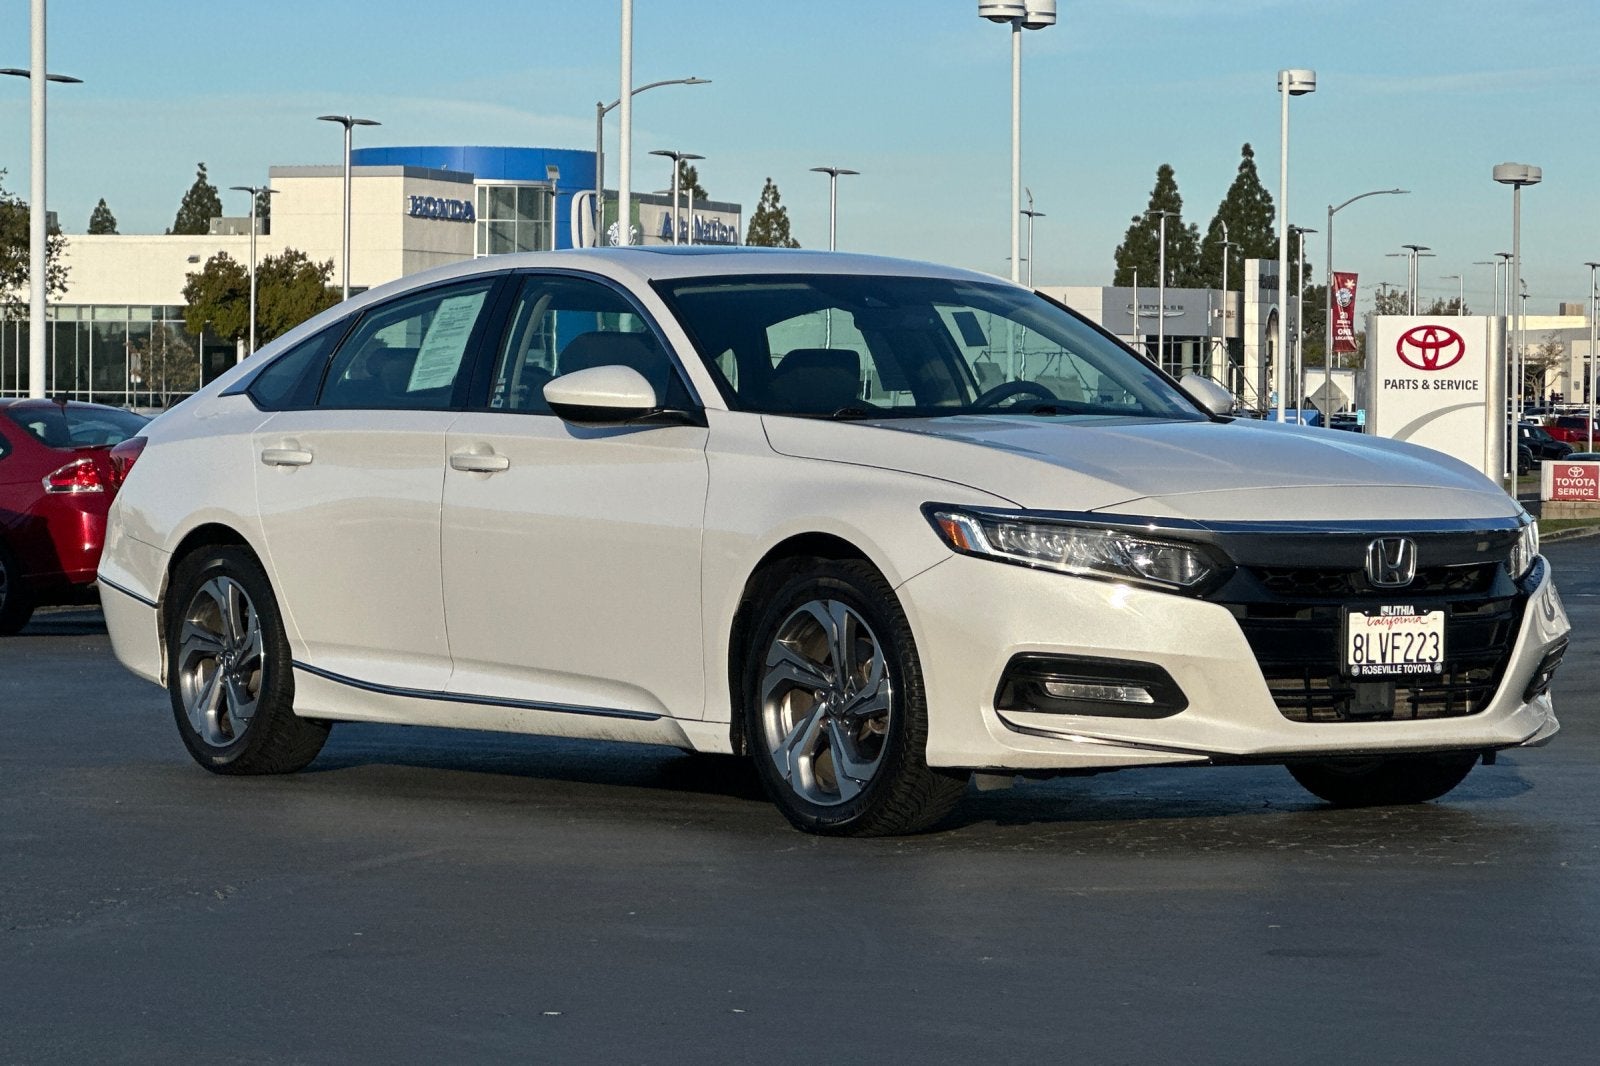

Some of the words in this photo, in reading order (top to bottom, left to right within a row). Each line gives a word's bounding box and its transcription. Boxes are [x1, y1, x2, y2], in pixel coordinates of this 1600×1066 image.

[407, 195, 475, 222] HONDA
[1384, 379, 1419, 390] PARTS
[1421, 379, 1430, 390] &
[1433, 379, 1479, 390] SERVICE
[1555, 477, 1596, 487] TOYOTA
[1557, 487, 1594, 496] SERVICE
[1389, 605, 1415, 616] LITHIA
[1366, 615, 1428, 630] California
[1353, 631, 1440, 664] 8LVF223
[1361, 664, 1402, 675] ROSEVILLE
[1403, 663, 1432, 674] TOYOTA
